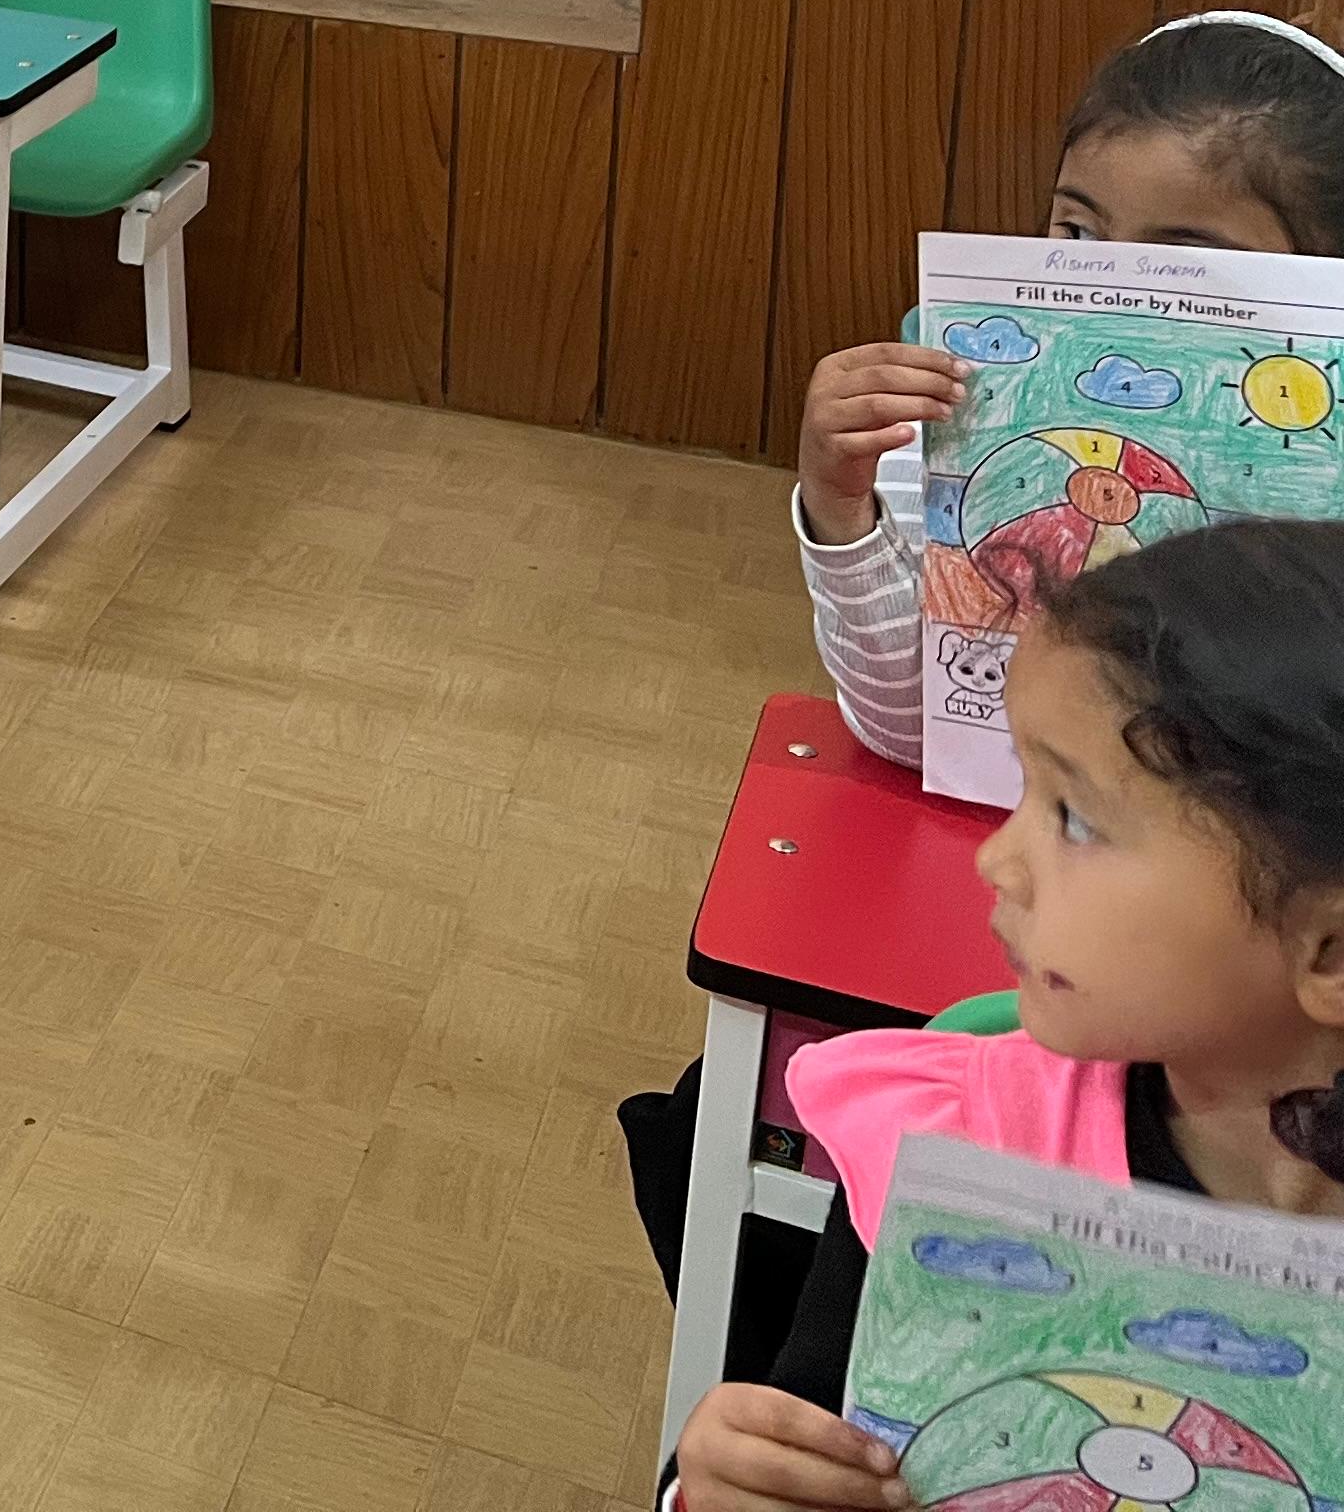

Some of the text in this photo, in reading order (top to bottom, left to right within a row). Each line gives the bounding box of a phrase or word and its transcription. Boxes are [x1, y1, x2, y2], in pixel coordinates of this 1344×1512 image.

[1015, 286, 1258, 320] Fill the Color by Number
